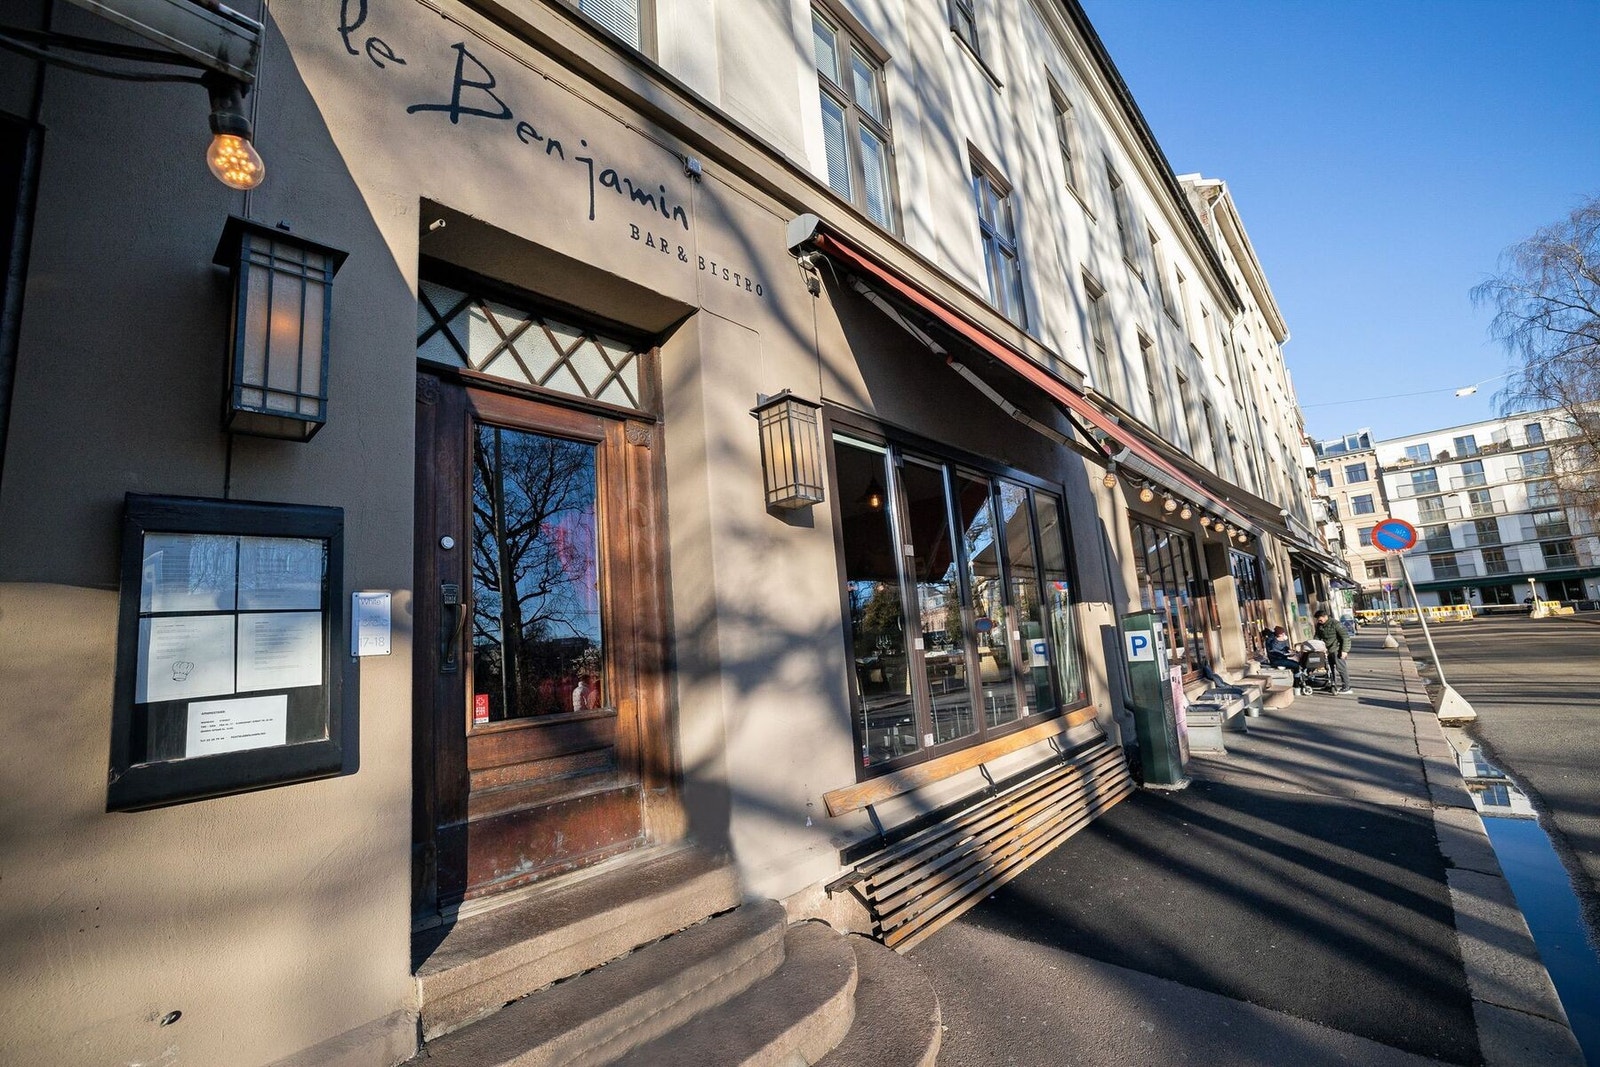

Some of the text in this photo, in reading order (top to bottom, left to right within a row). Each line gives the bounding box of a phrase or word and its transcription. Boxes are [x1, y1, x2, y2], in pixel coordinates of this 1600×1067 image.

[406, 41, 689, 231] Benjamin
[629, 223, 763, 297] BAR & BISTRO
[1130, 635, 1148, 656] P
